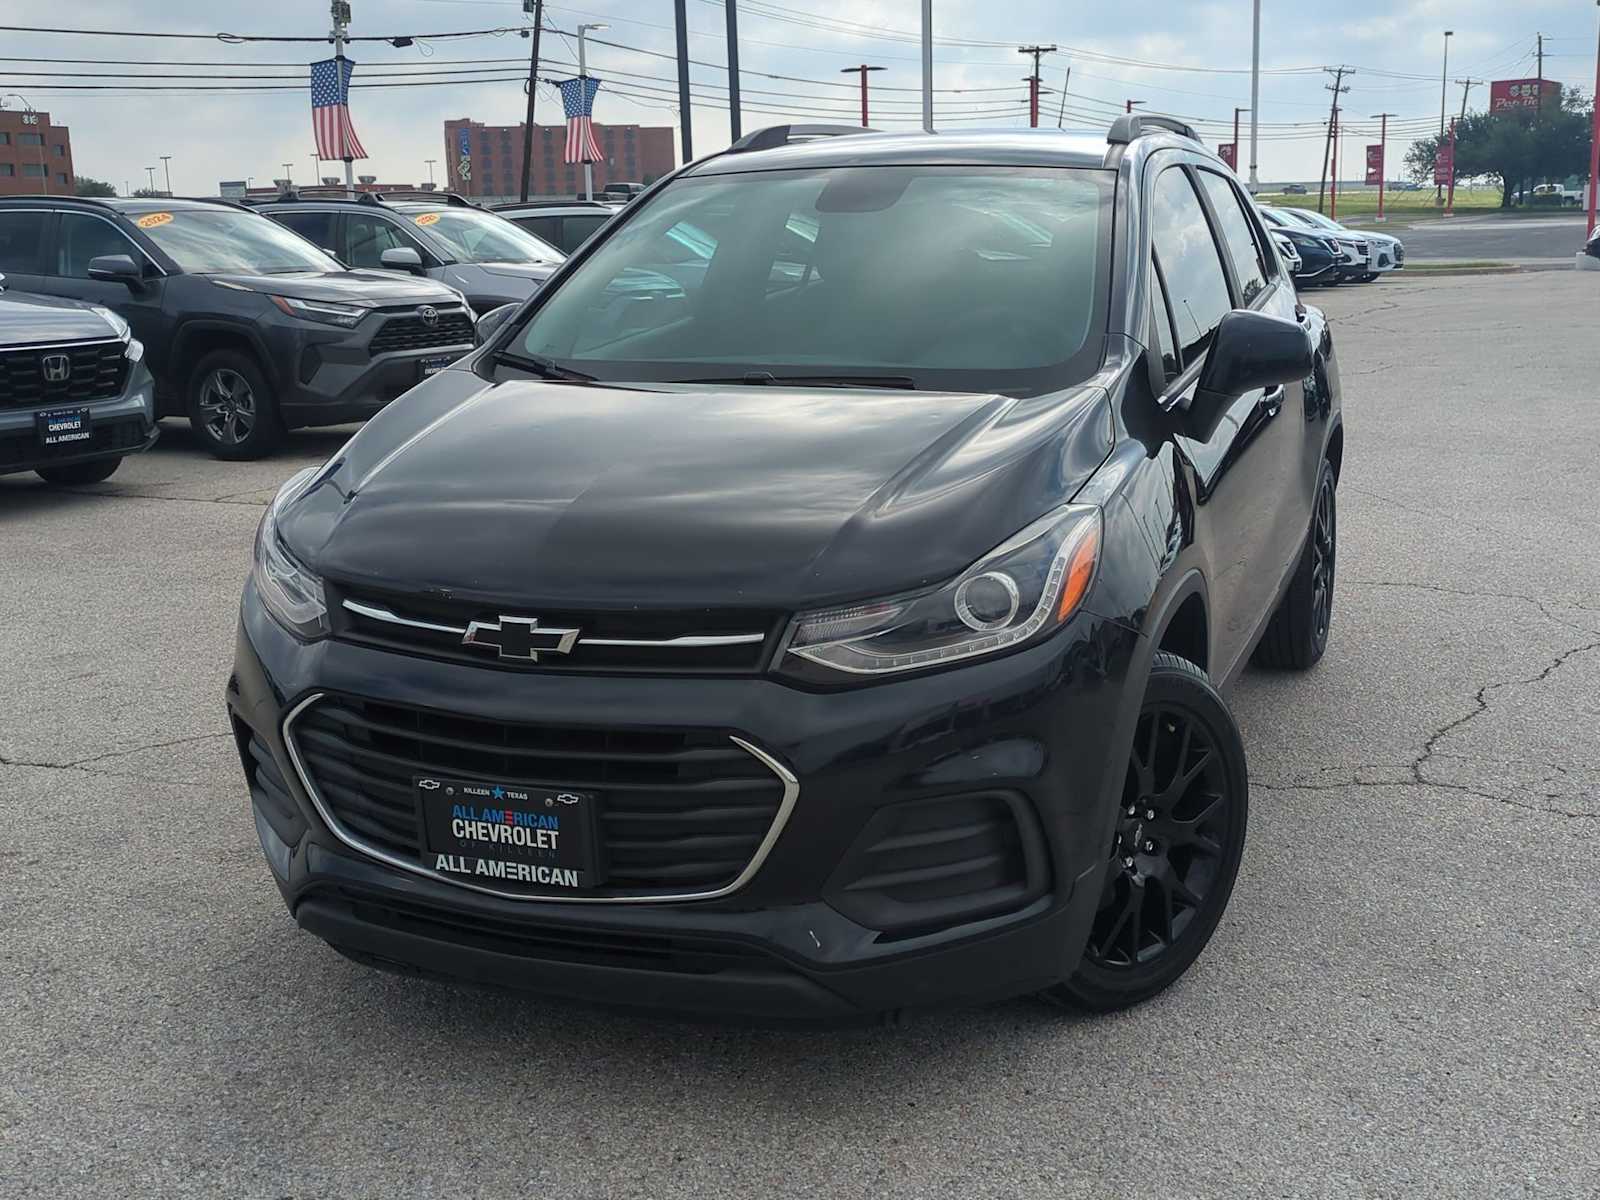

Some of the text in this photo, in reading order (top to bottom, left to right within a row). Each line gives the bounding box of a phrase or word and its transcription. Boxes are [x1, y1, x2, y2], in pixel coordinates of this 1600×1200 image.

[48, 421, 80, 431] CHEVROLET
[58, 432, 89, 442] AMERICAN
[464, 787, 528, 800] KILLEEN TEXAS
[452, 804, 559, 830] ALL AMERICAN
[452, 819, 559, 849] CHEVROLET
[436, 854, 578, 887] ALL AMERICAN
